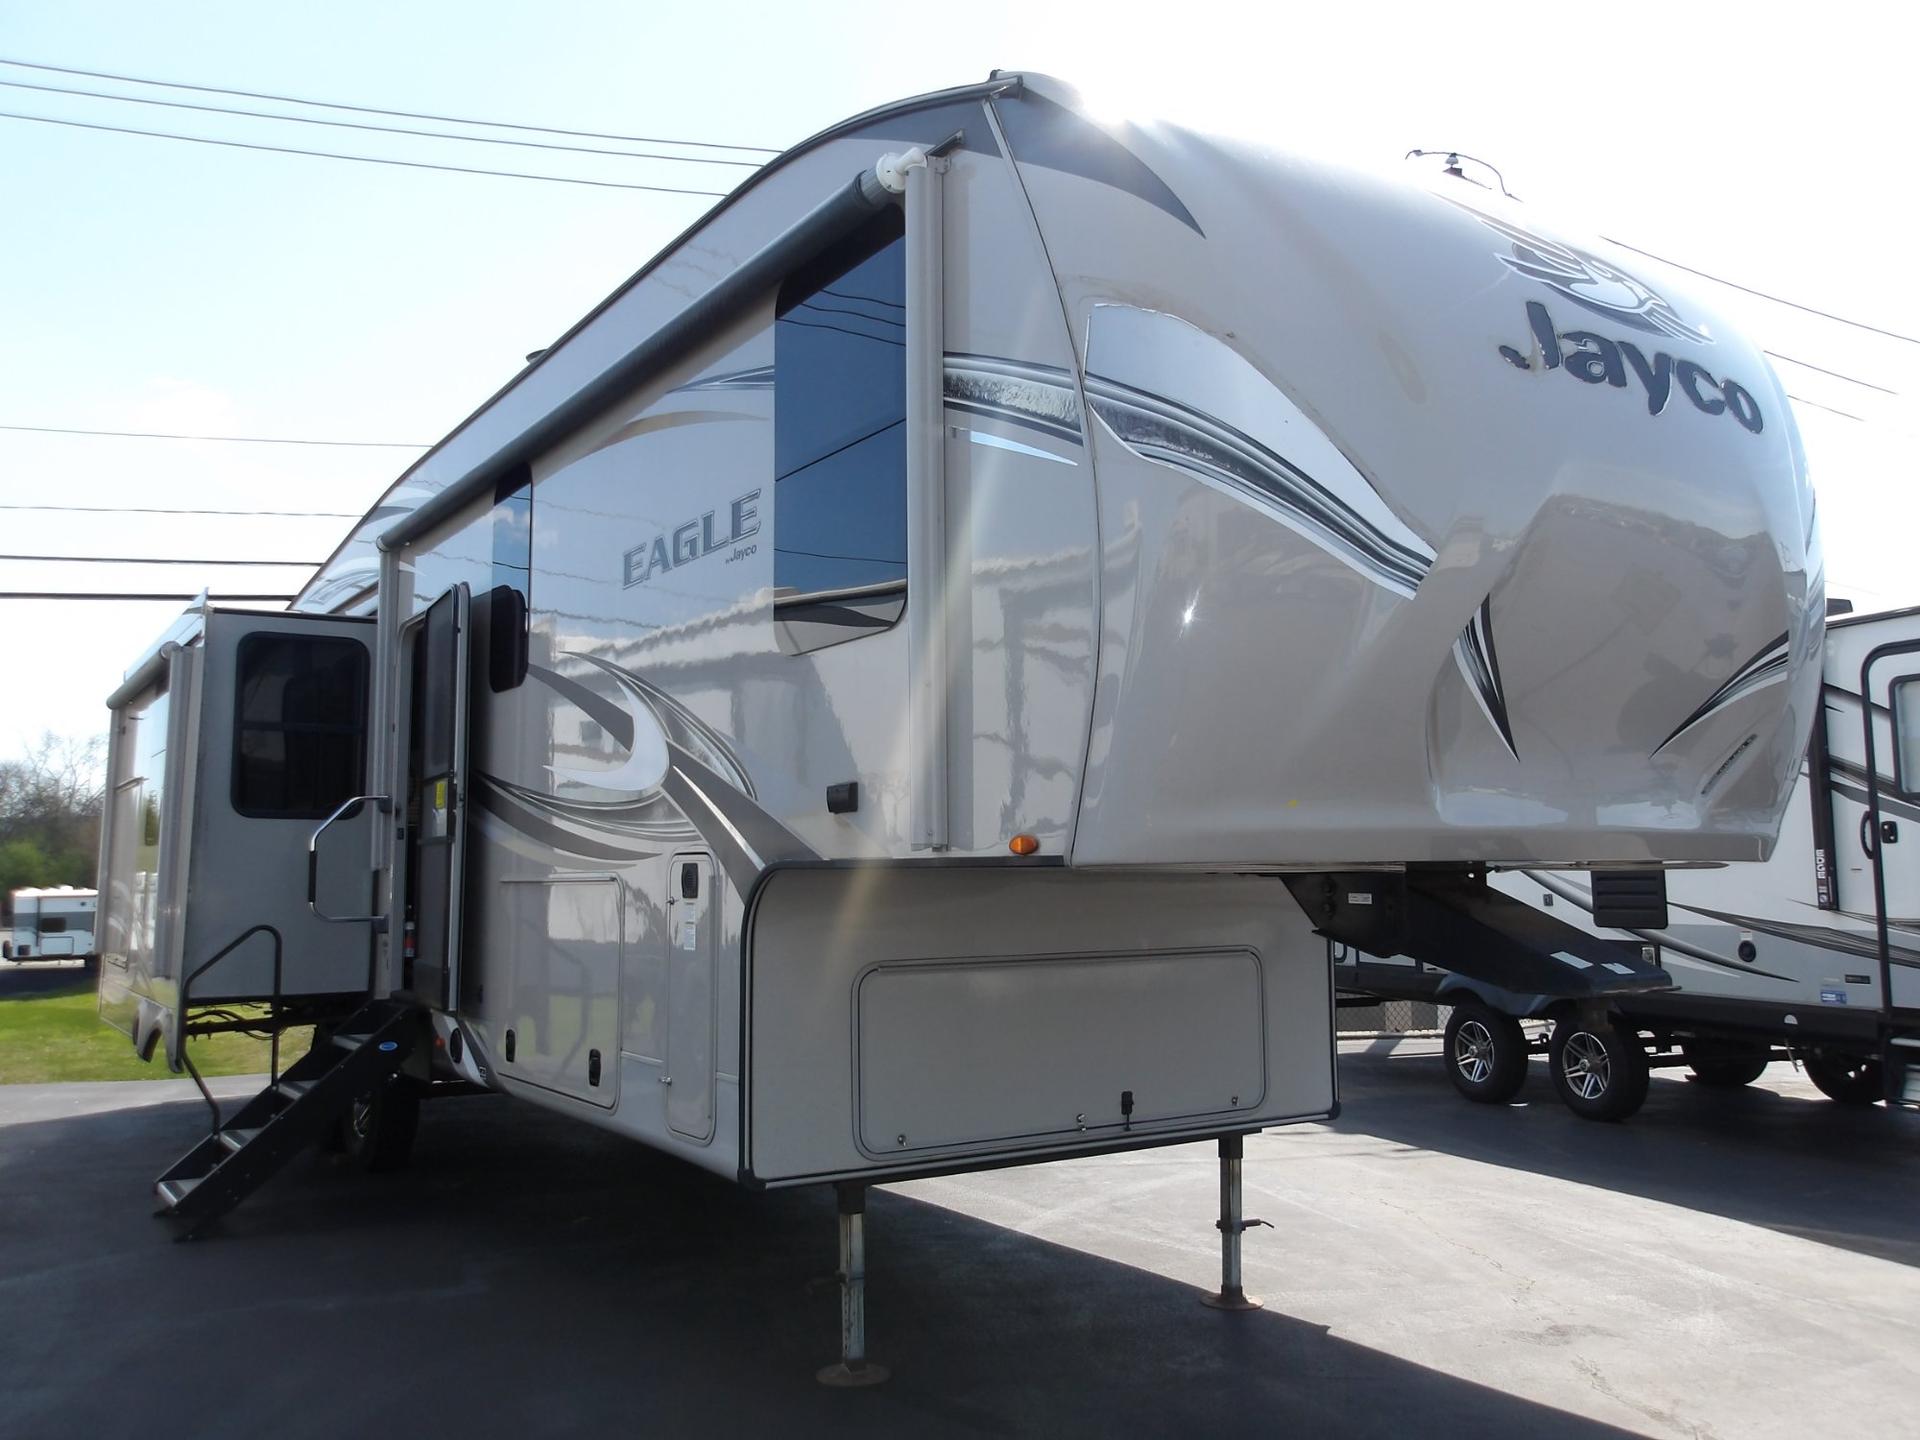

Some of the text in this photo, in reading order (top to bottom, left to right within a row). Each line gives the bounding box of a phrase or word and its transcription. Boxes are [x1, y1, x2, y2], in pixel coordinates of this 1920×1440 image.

[1498, 301, 1764, 434] Jayco
[623, 487, 762, 590] EAGLE
[730, 544, 757, 561] Jayco
[1816, 849, 1826, 879] EDGE
